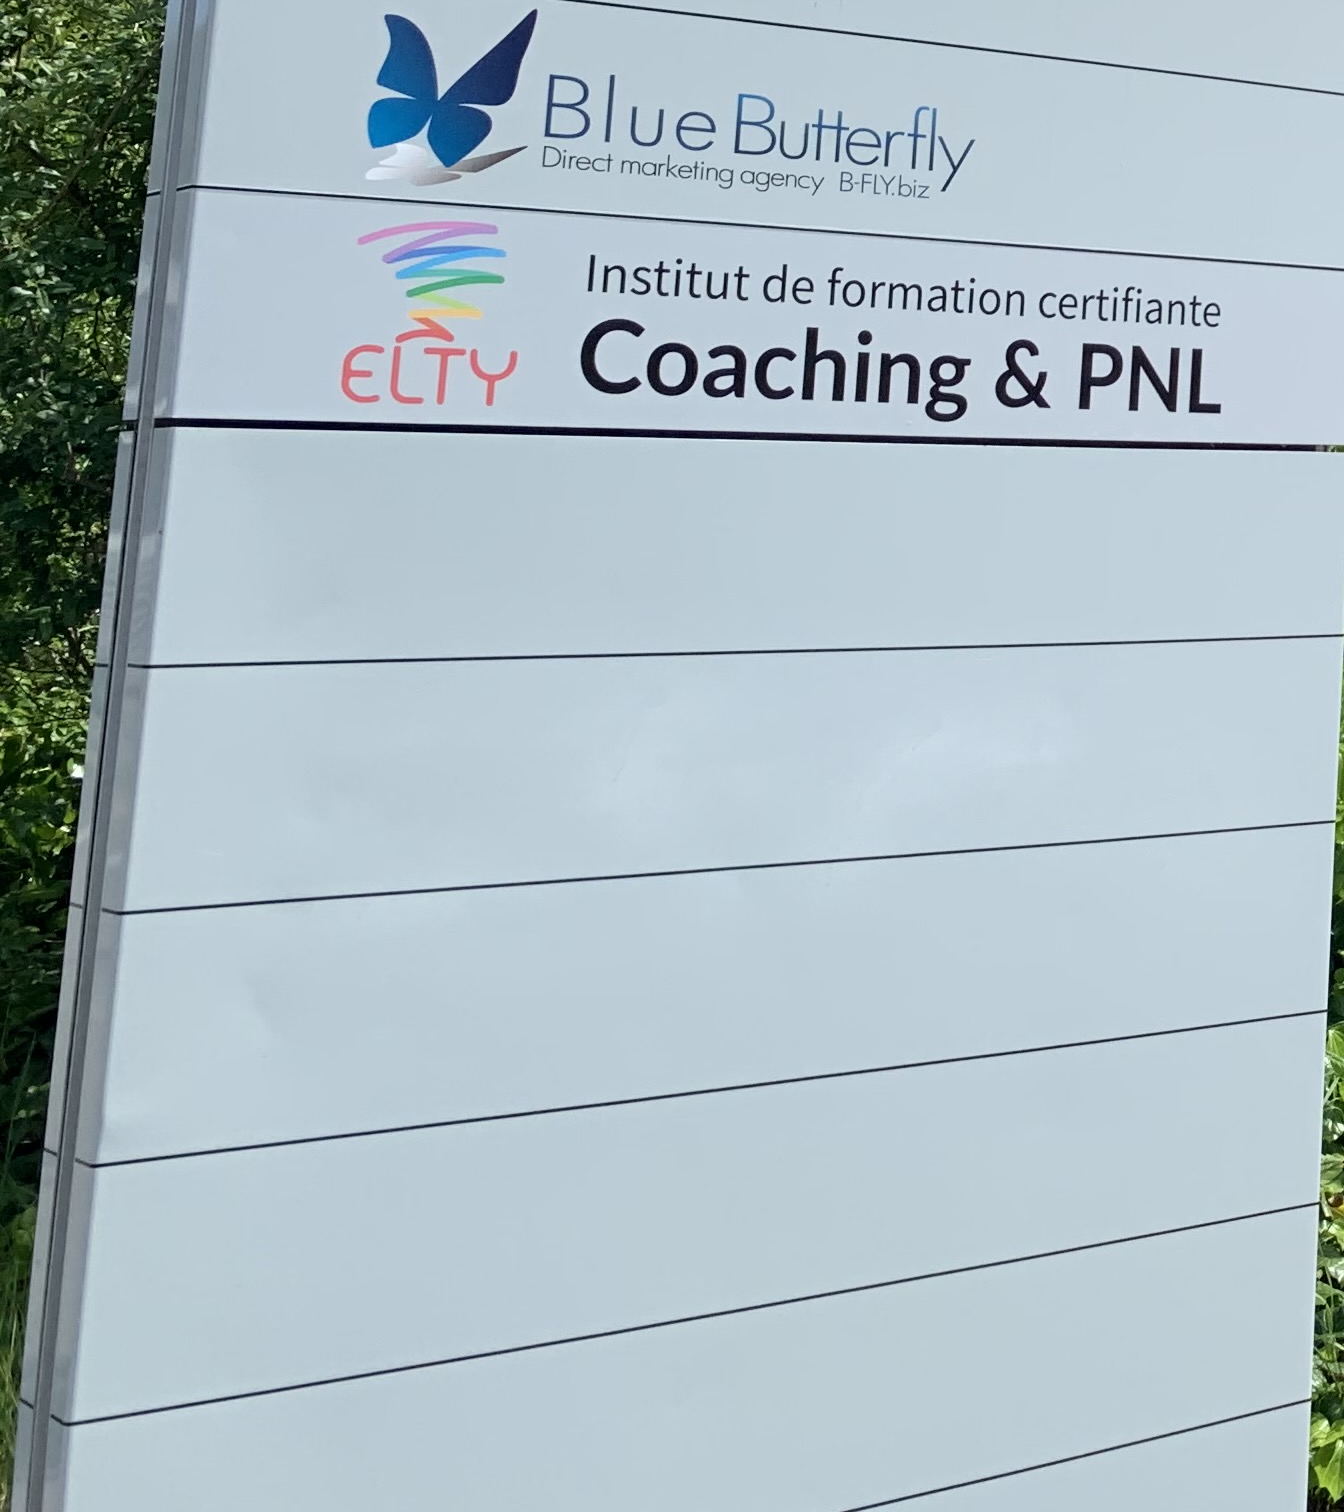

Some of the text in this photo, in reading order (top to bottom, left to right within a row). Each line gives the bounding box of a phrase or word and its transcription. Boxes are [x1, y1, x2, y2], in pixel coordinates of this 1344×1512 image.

[541, 146, 931, 199] Direct marketing agency B-FLY.biz
[542, 74, 976, 192] Blue Butterfly
[587, 254, 1221, 328] Institut de formation certifiante
[579, 319, 1222, 423] Coaching & PNL
